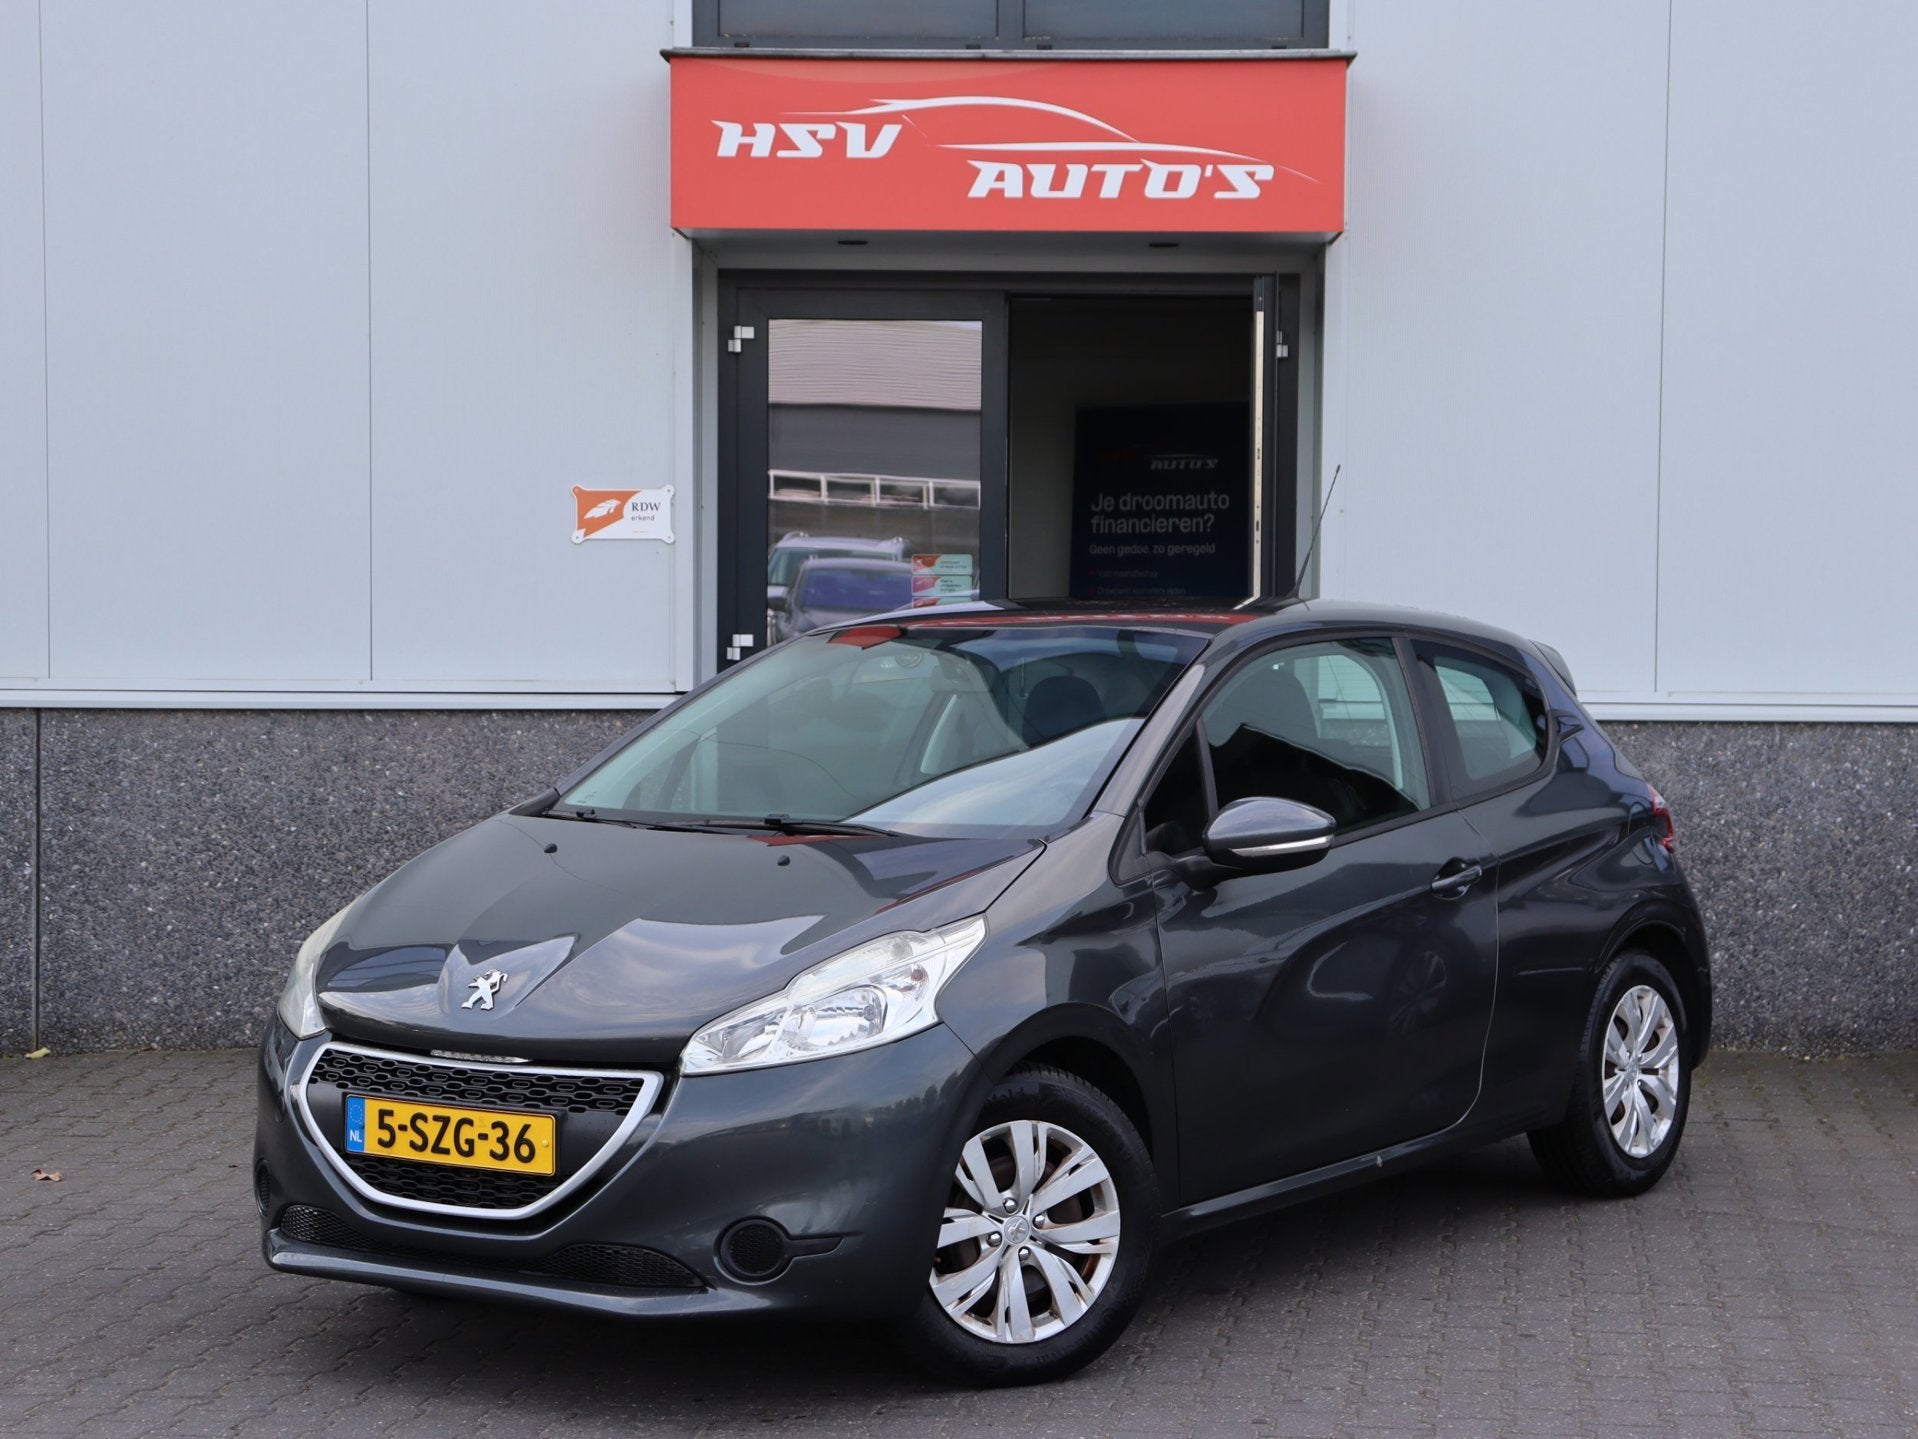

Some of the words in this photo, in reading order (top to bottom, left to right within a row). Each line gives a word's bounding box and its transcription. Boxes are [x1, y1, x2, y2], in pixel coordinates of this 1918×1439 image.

[711, 120, 902, 158] HSV
[967, 159, 1274, 198] AUTO'S
[631, 501, 662, 511] RDW
[1090, 492, 1115, 511] Je
[1119, 490, 1230, 511] droomauto
[1090, 513, 1215, 534] financieren?
[1089, 543, 1116, 554] Geen
[1152, 544, 1165, 554] zo
[1167, 542, 1216, 556] geregeld
[349, 1129, 363, 1143] NL
[377, 1108, 536, 1164] 5-SZG-36
